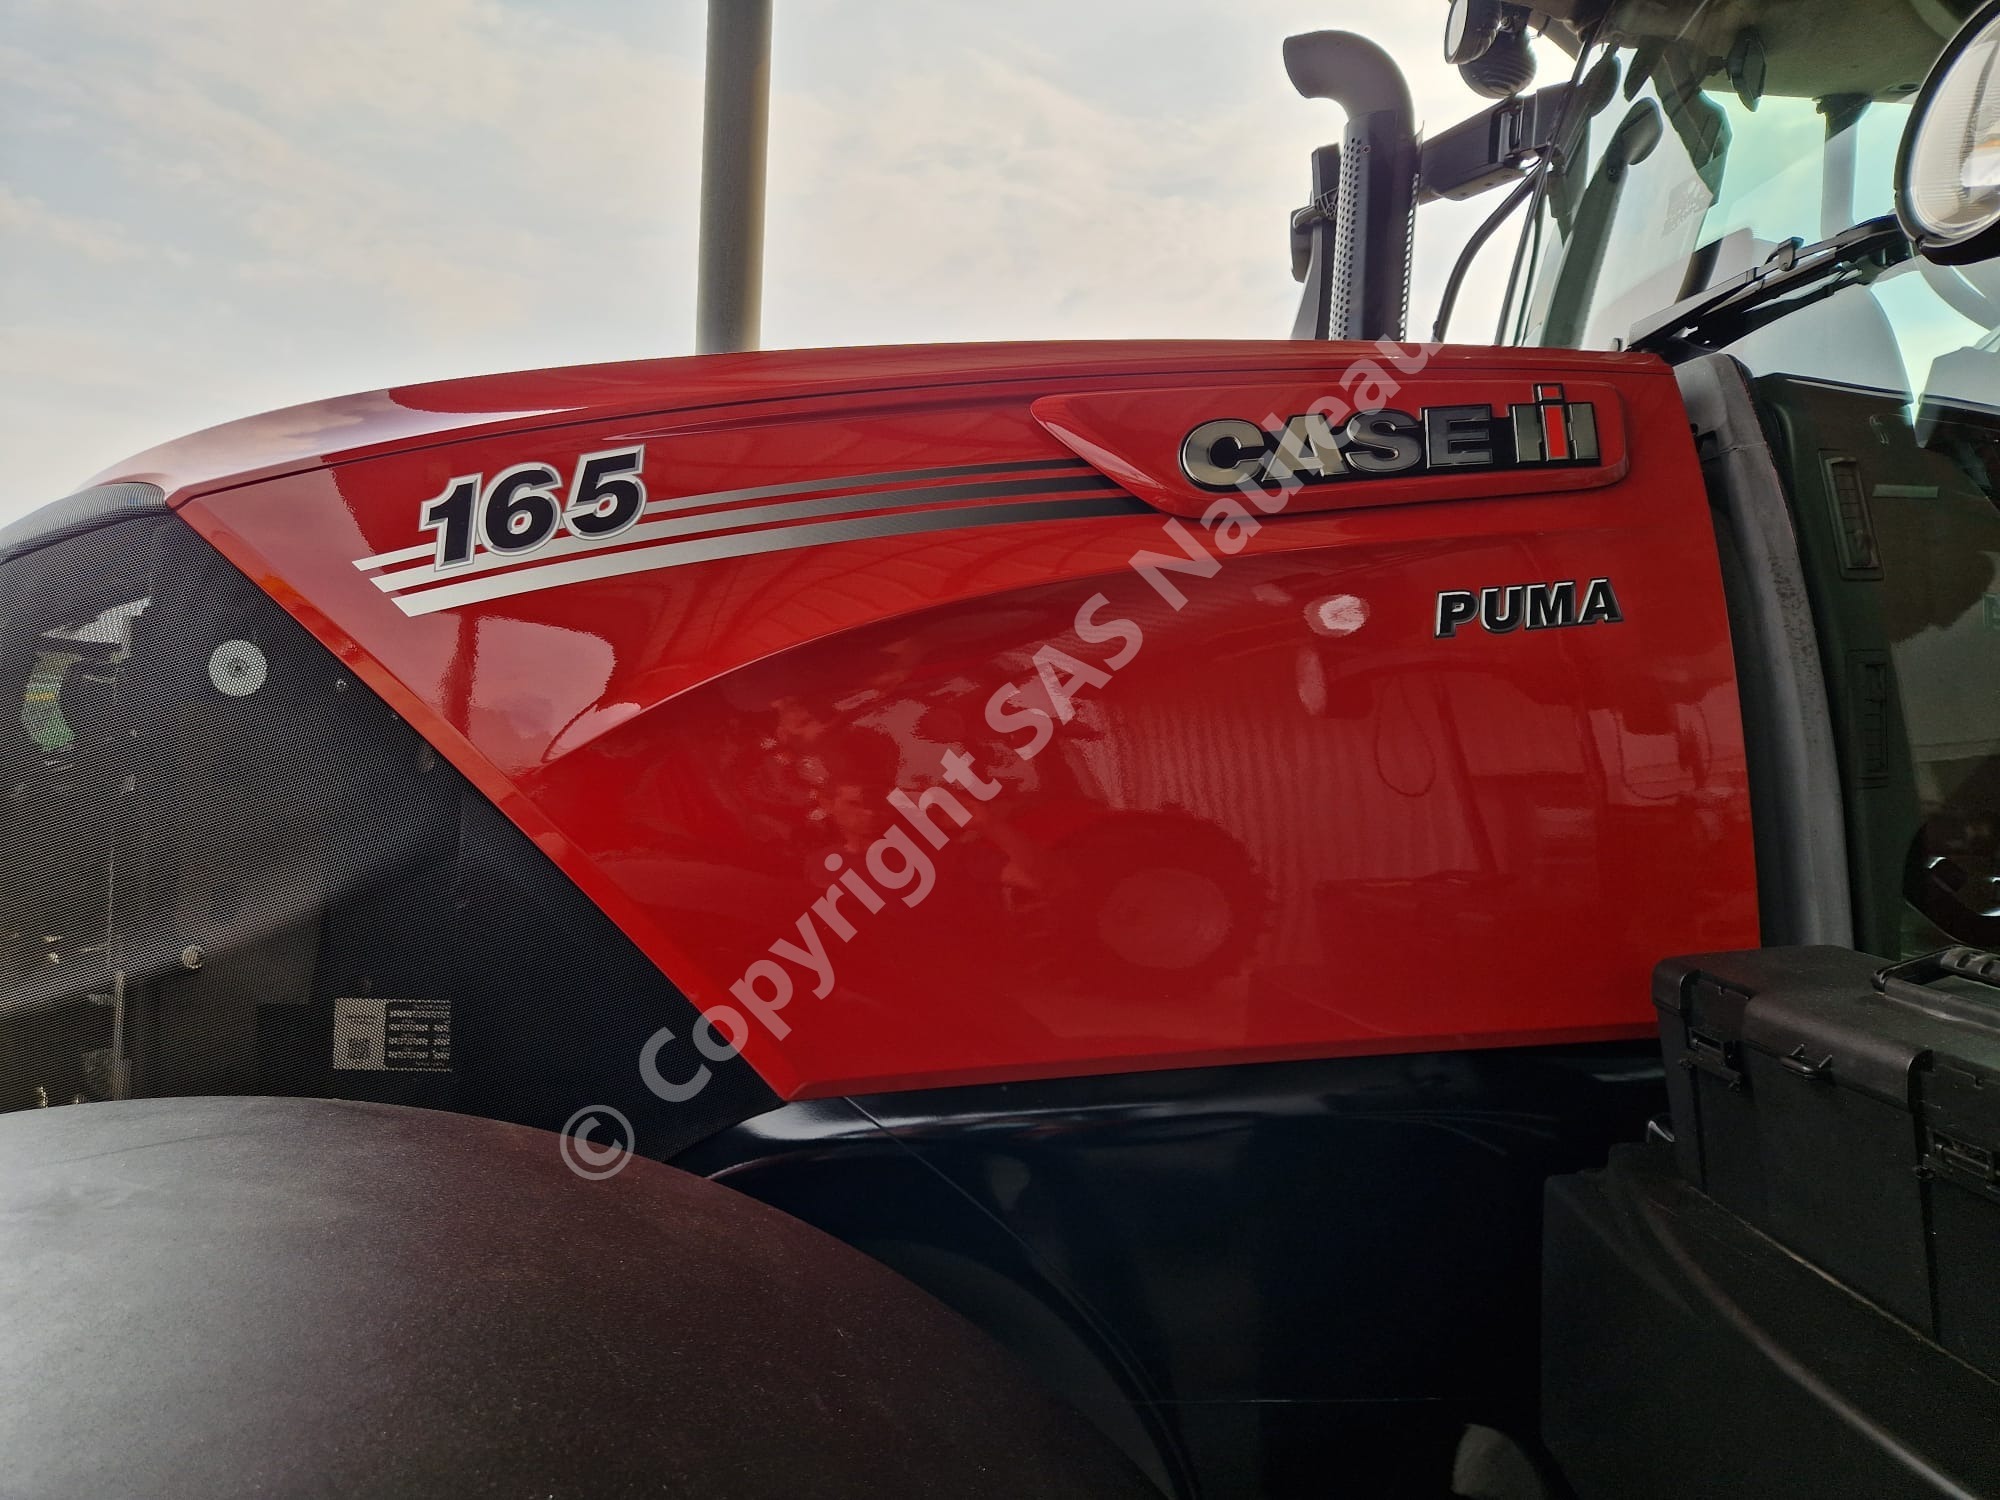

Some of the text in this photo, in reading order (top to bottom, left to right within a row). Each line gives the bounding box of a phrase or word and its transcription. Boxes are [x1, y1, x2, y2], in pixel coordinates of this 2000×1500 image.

[1178, 405, 1493, 494] CASE
[419, 444, 647, 573] 165
[1434, 578, 1624, 639] PUMA
